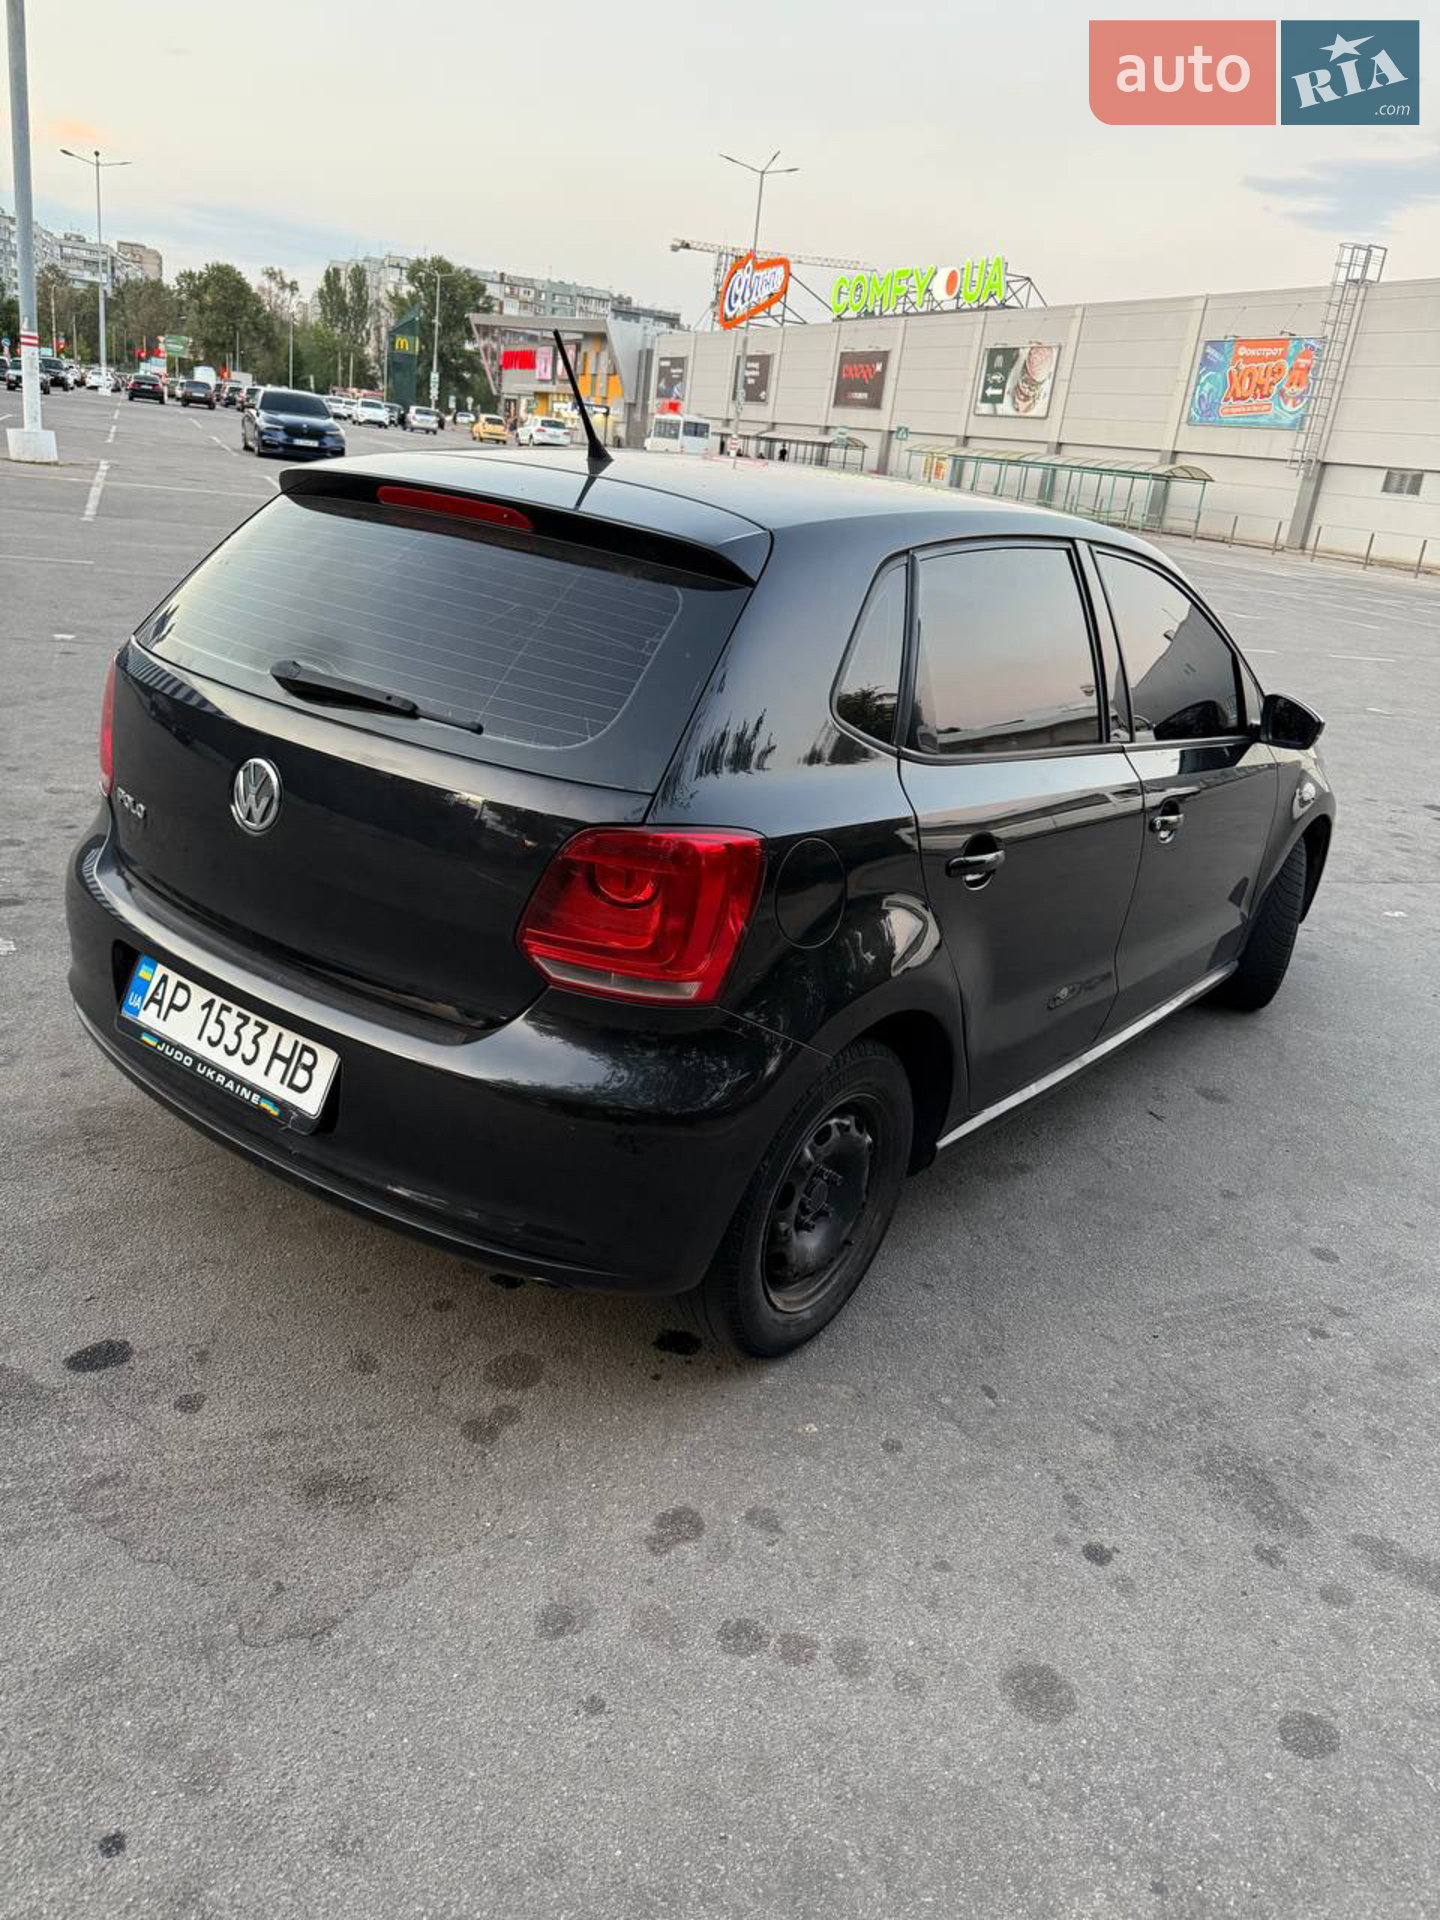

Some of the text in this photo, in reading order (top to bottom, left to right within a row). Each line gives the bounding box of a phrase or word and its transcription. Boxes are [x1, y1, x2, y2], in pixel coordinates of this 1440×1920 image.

[831, 264, 935, 314] COMFY
[1238, 346, 1284, 358] Фокстрот
[117, 786, 146, 819] POLO
[127, 992, 142, 1010] UA
[143, 973, 319, 1094] AP 1533 HB
[156, 1040, 261, 1106] JUDO UKRAINE
